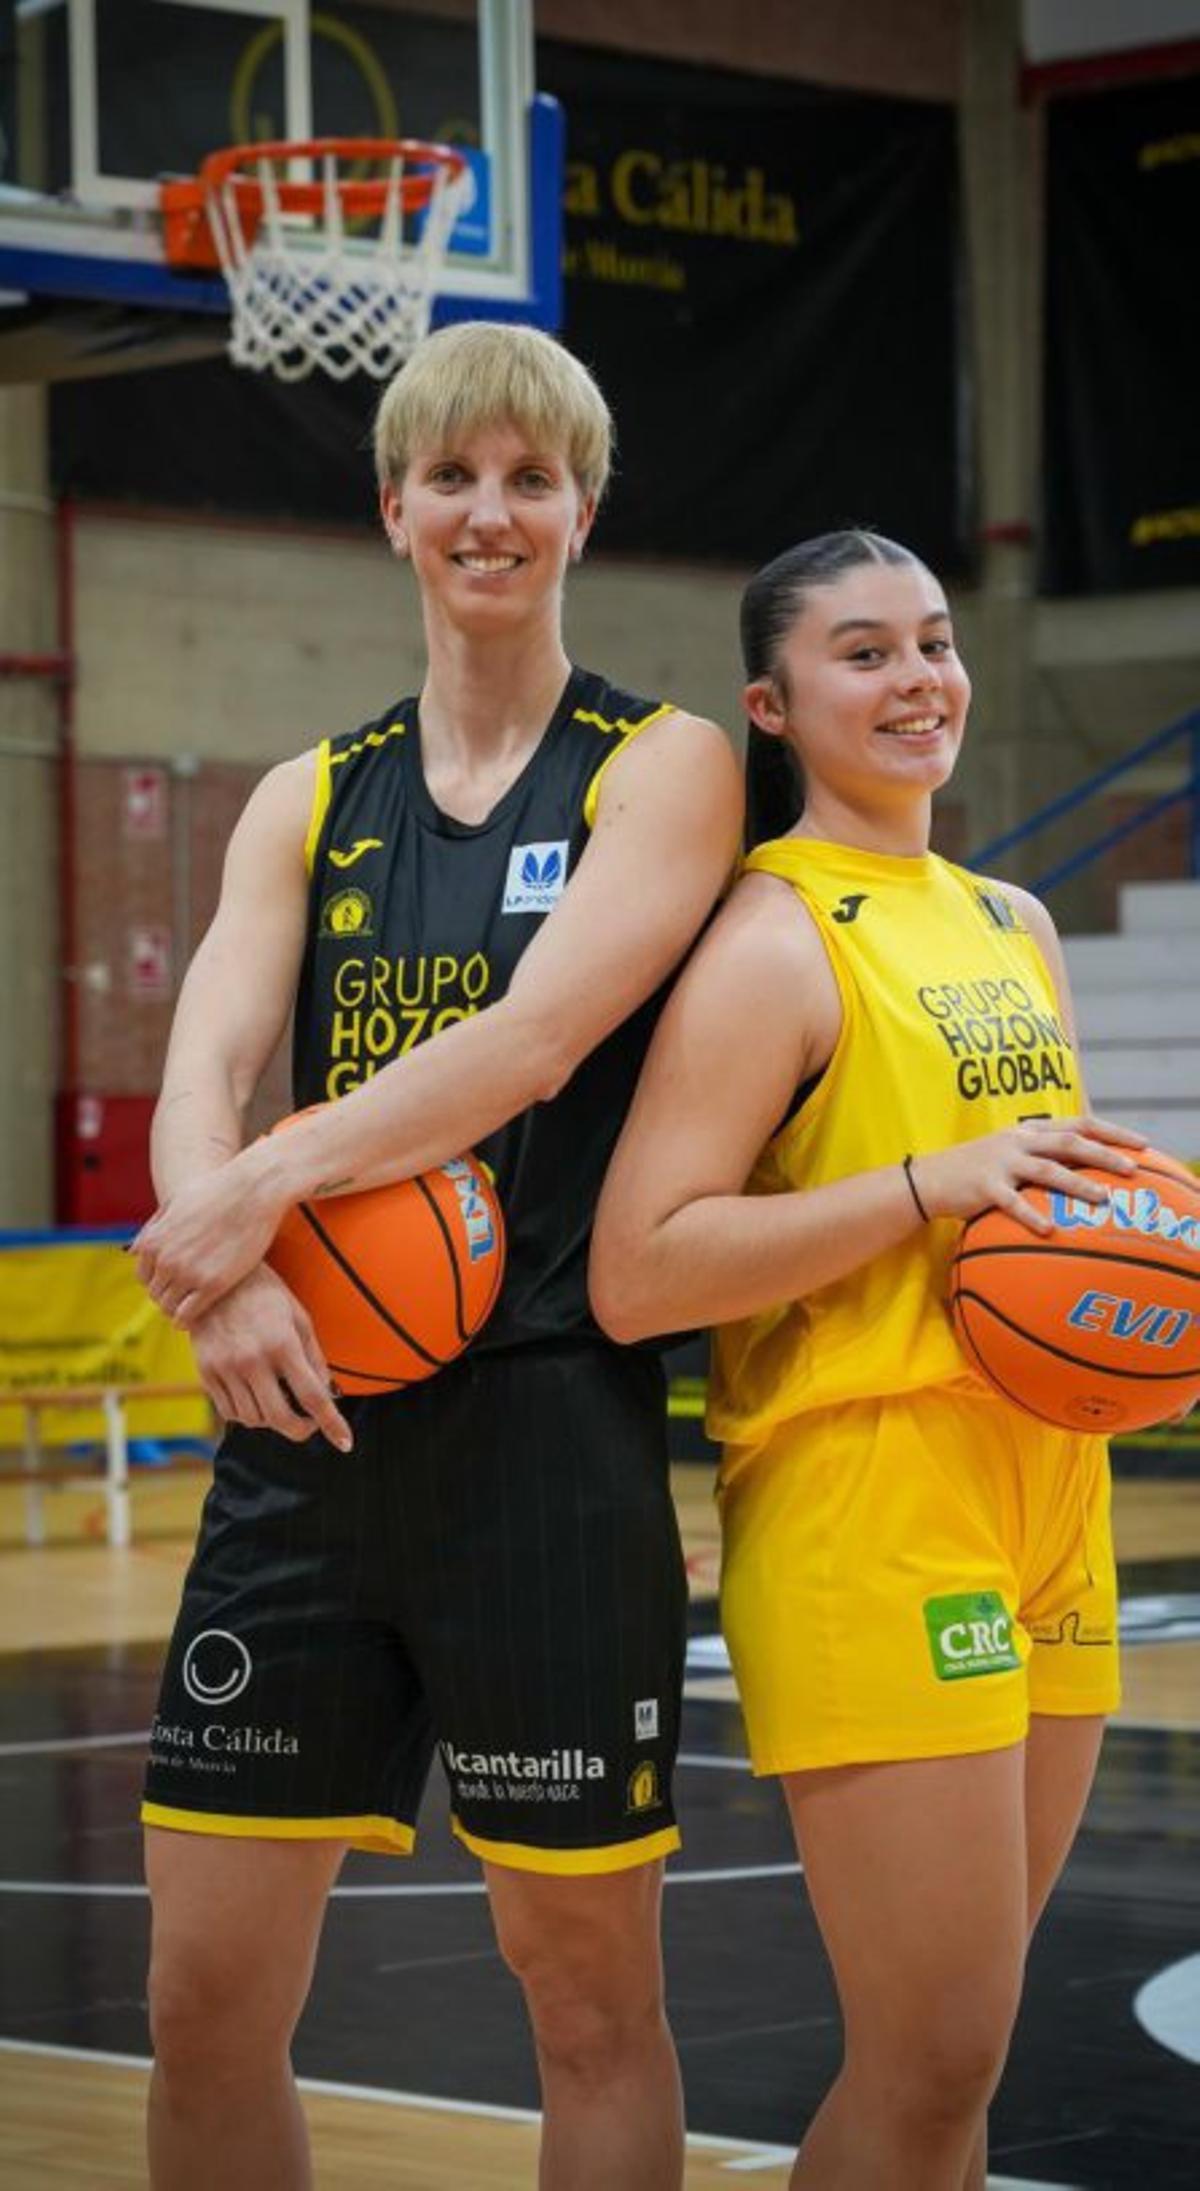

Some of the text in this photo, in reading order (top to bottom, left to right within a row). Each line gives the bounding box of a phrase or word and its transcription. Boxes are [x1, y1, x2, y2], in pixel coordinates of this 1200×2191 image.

[611, 150, 799, 246] Cálida
[334, 951, 490, 1008] GRUPO
[918, 978, 1033, 1019] GRUPO
[957, 1050, 1072, 1101] GLOBAL
[1067, 1289, 1192, 1349] EVO
[940, 1614, 1010, 1660] CRC
[202, 1724, 300, 1755] Cálida
